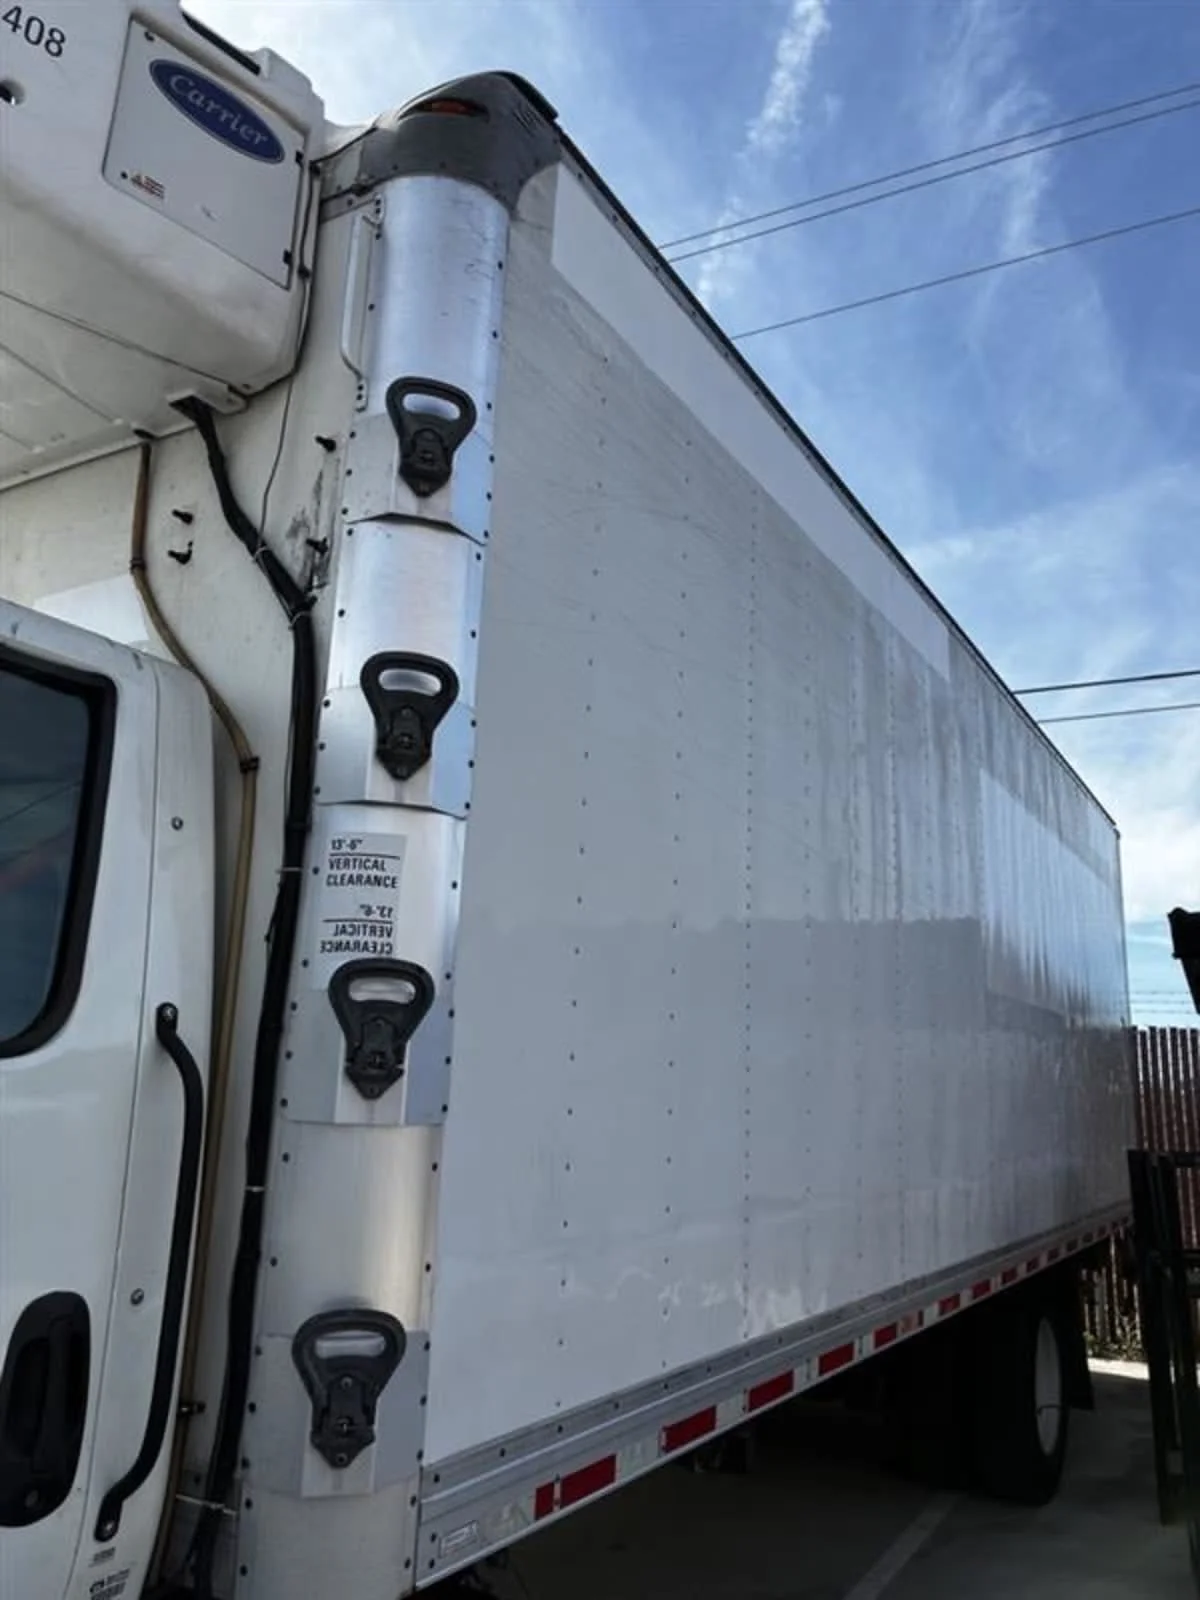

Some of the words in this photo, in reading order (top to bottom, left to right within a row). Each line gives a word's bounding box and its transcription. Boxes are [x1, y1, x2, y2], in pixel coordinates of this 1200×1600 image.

[2, 5, 66, 58] 408
[169, 74, 268, 145] Carrier
[326, 874, 398, 888] CLEARANCE
[328, 858, 386, 872] VERTICAL
